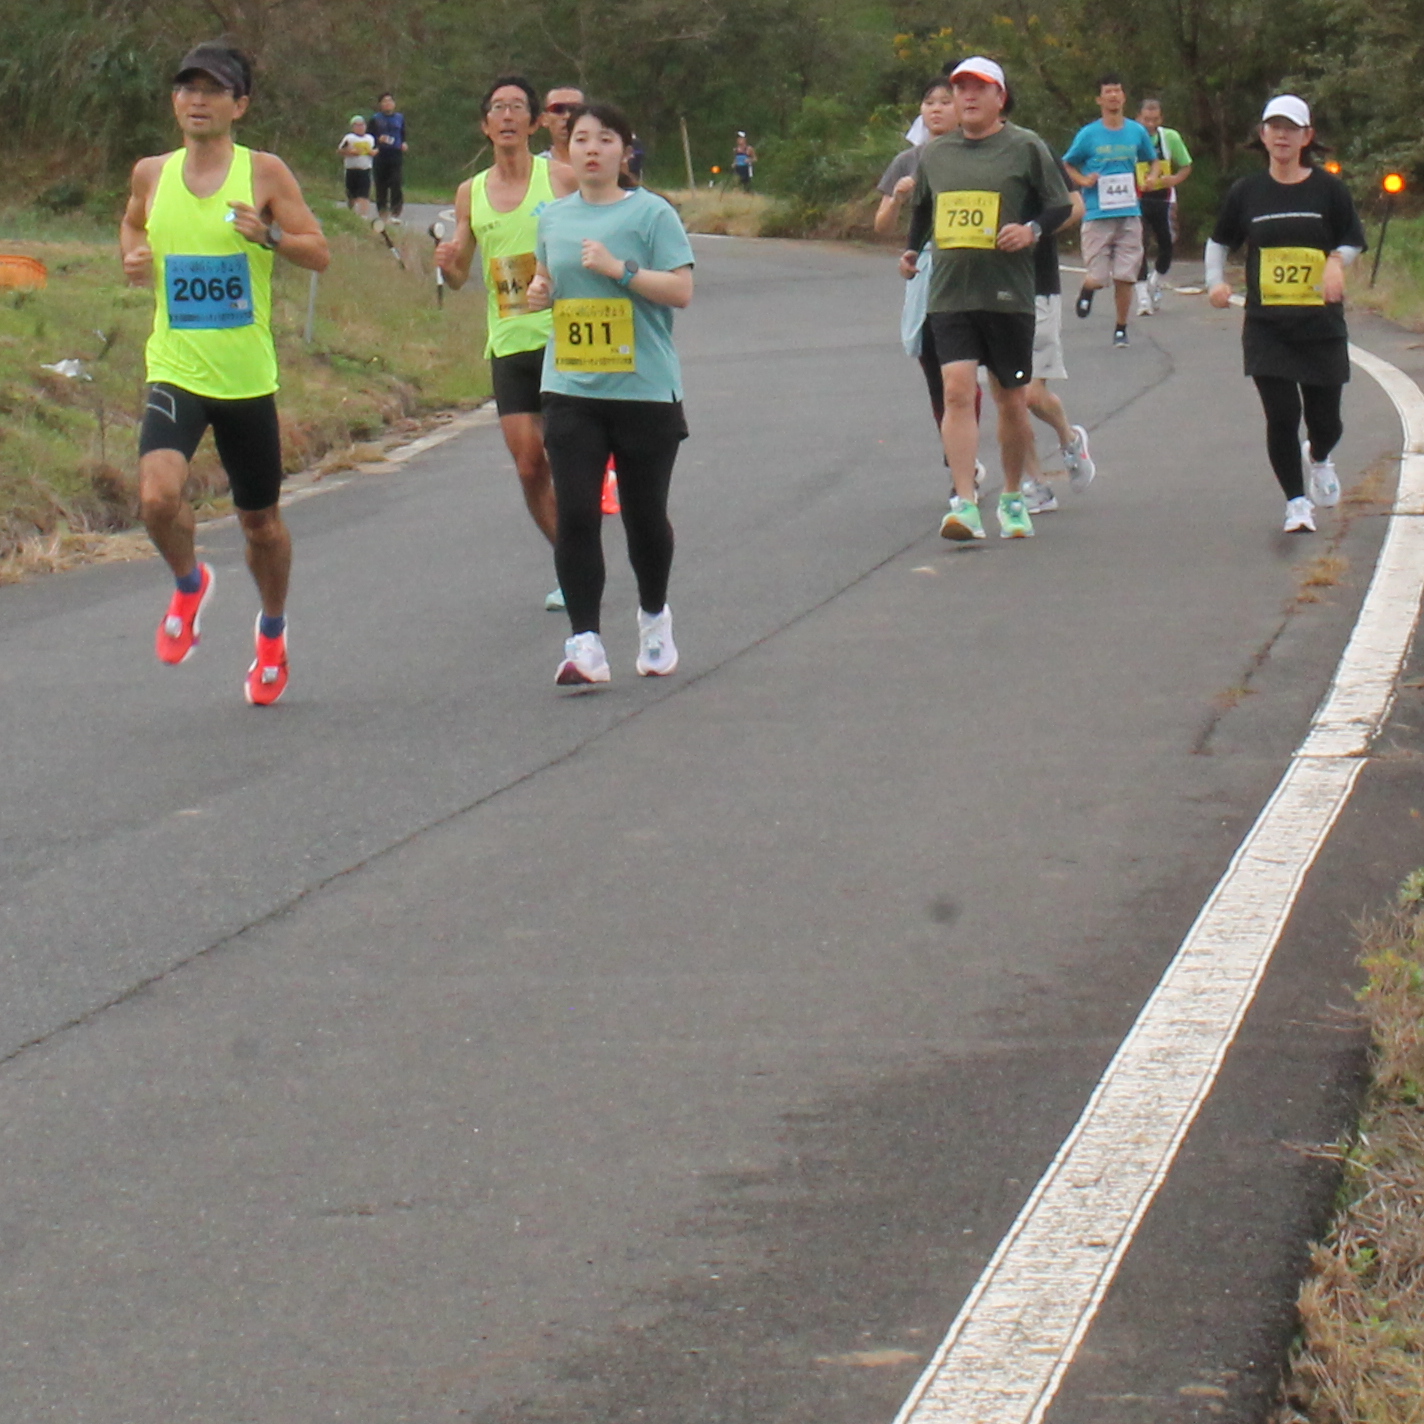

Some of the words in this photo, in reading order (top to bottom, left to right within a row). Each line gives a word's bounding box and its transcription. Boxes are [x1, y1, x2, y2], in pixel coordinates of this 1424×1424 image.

[1106, 183, 1129, 196] 444
[947, 208, 984, 228] 730
[1273, 265, 1312, 285] 927
[173, 276, 243, 302] 2066
[569, 321, 612, 346] 811
